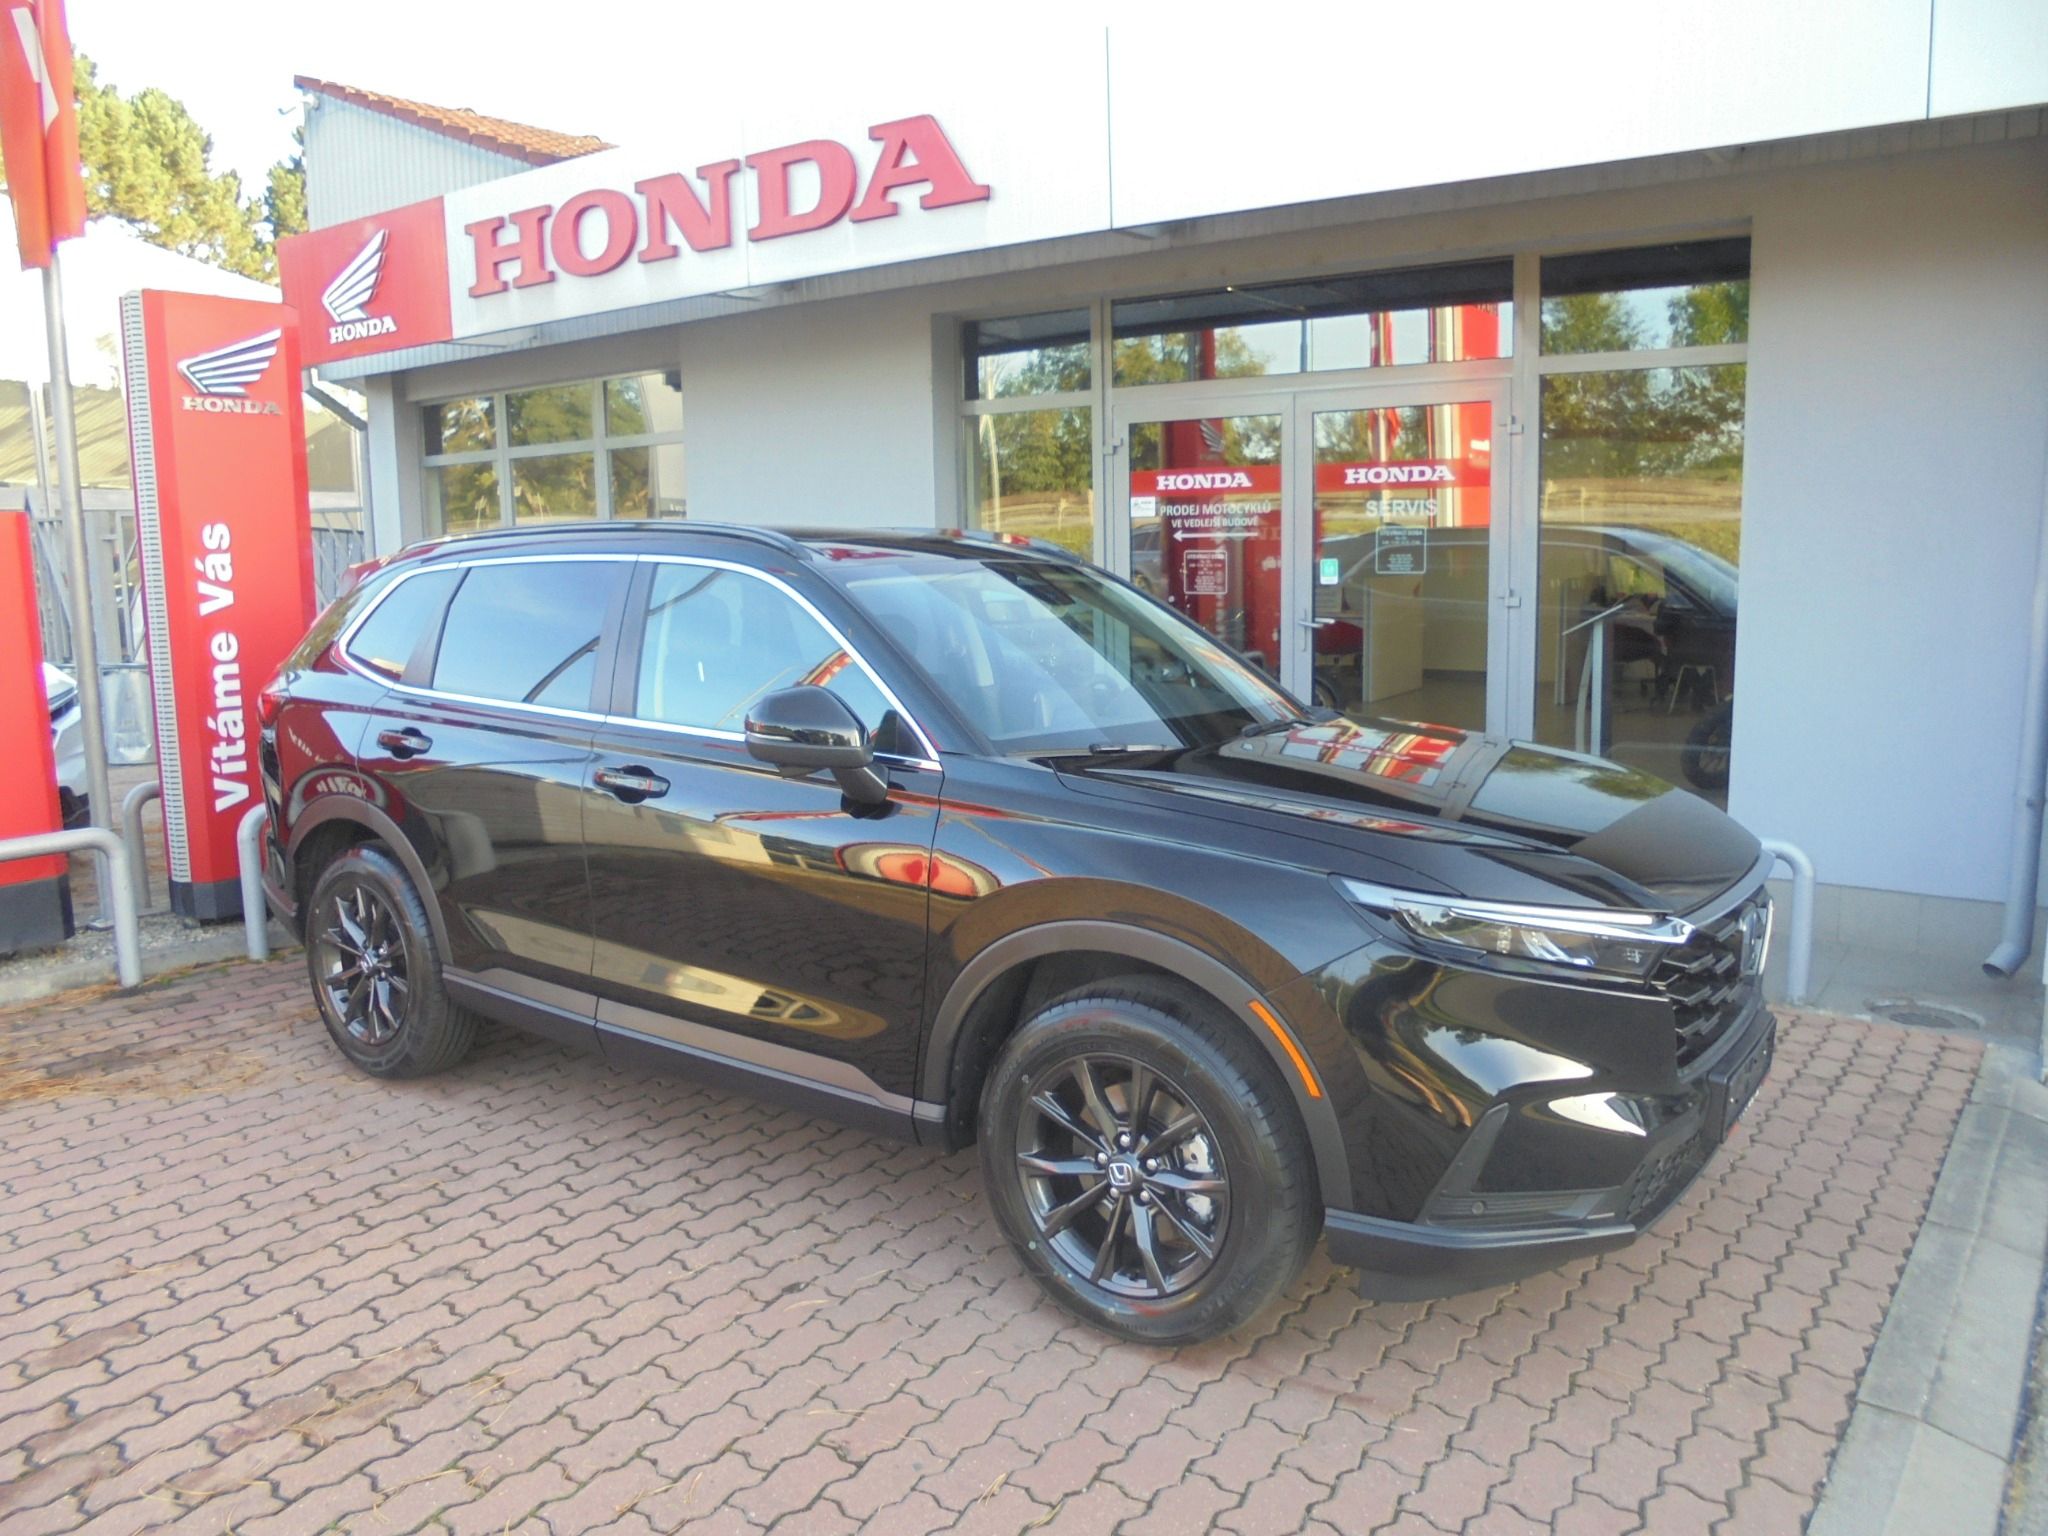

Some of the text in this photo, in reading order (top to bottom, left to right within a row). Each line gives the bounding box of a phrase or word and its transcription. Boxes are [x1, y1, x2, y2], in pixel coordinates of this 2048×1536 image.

[465, 114, 991, 298] HONDA
[329, 316, 397, 344] HONDA
[182, 396, 282, 415] HONDA
[1156, 472, 1252, 490] HONDA
[1344, 465, 1456, 484] HONDA
[1160, 504, 1199, 516] PRODEJ
[1366, 499, 1437, 517] SERVIS
[1171, 519, 1182, 528] VE
[194, 522, 250, 813] Vítáme Vás
